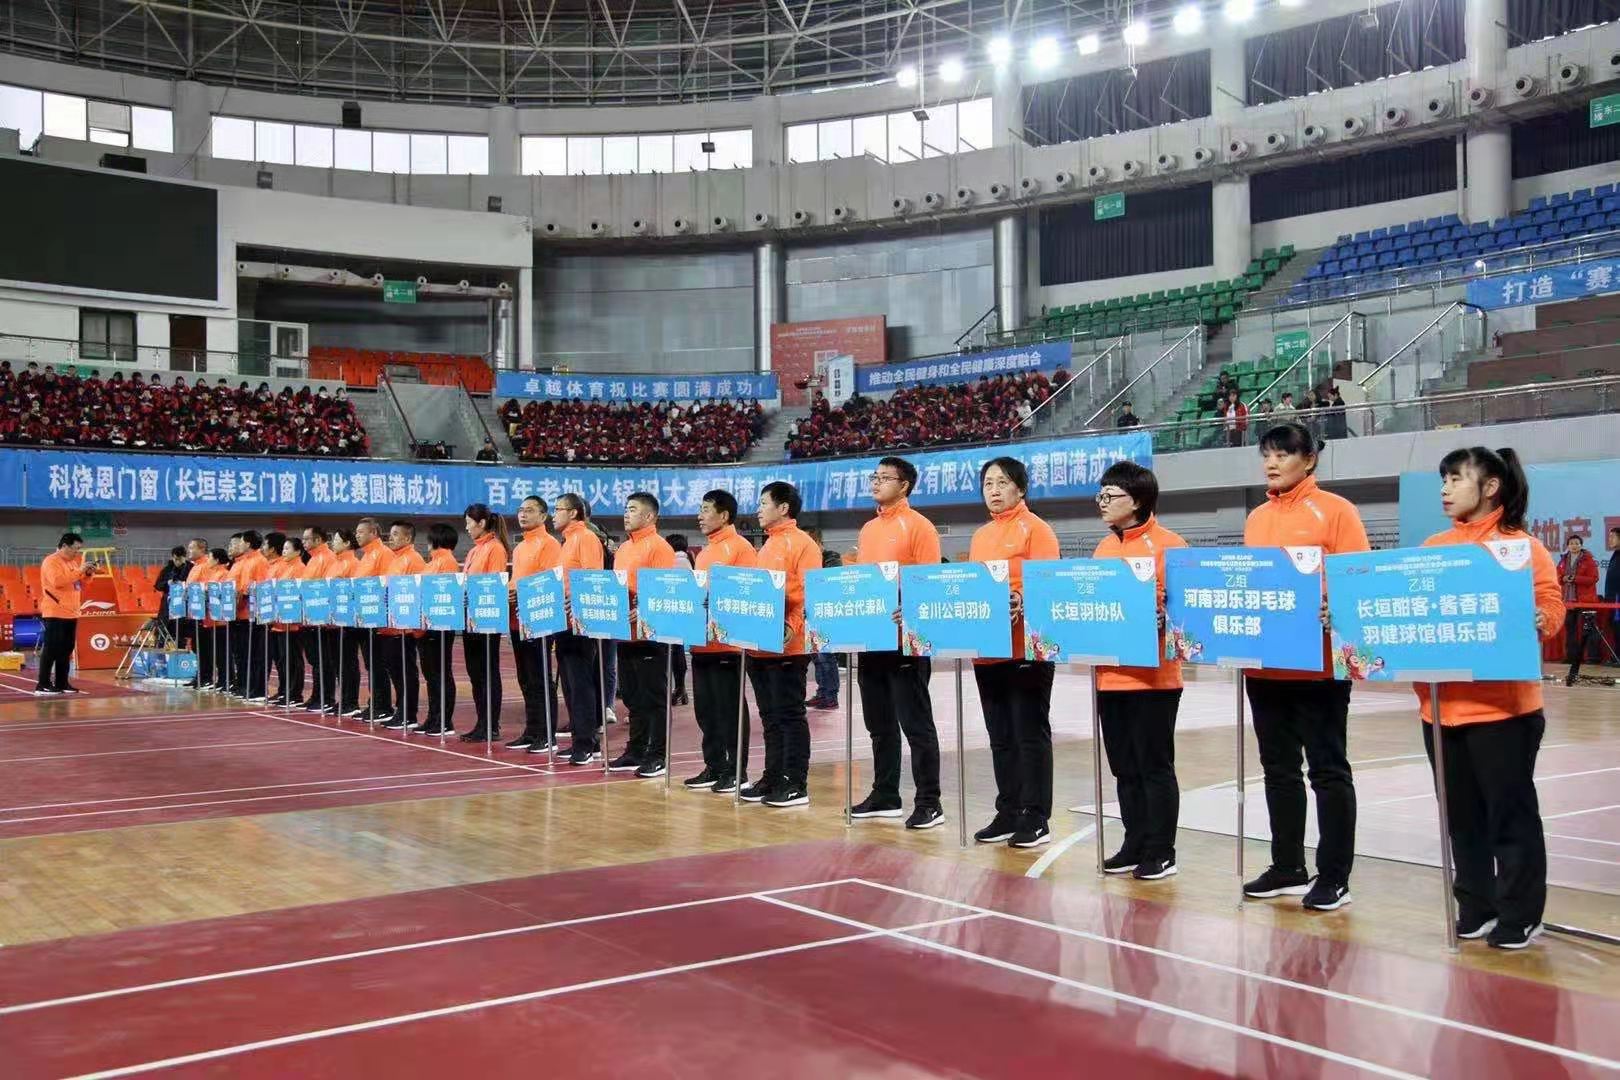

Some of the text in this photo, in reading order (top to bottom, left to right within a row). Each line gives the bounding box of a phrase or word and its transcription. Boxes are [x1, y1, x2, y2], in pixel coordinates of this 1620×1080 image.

[869, 351, 1042, 386] 推动全民健身和全民健康深度融合
[1225, 575, 1247, 588] 乙组
[1408, 577, 1436, 593] 乙组
[813, 598, 887, 618] 河南众合代表队
[917, 600, 991, 620] 金川公司羽协
[1183, 588, 1296, 611] 河南羽乐羽毛球
[1051, 601, 1125, 623] 长垣羽协队
[1213, 615, 1262, 636] 俱乐部
[1363, 621, 1497, 645] 羽健球馆俱乐部
